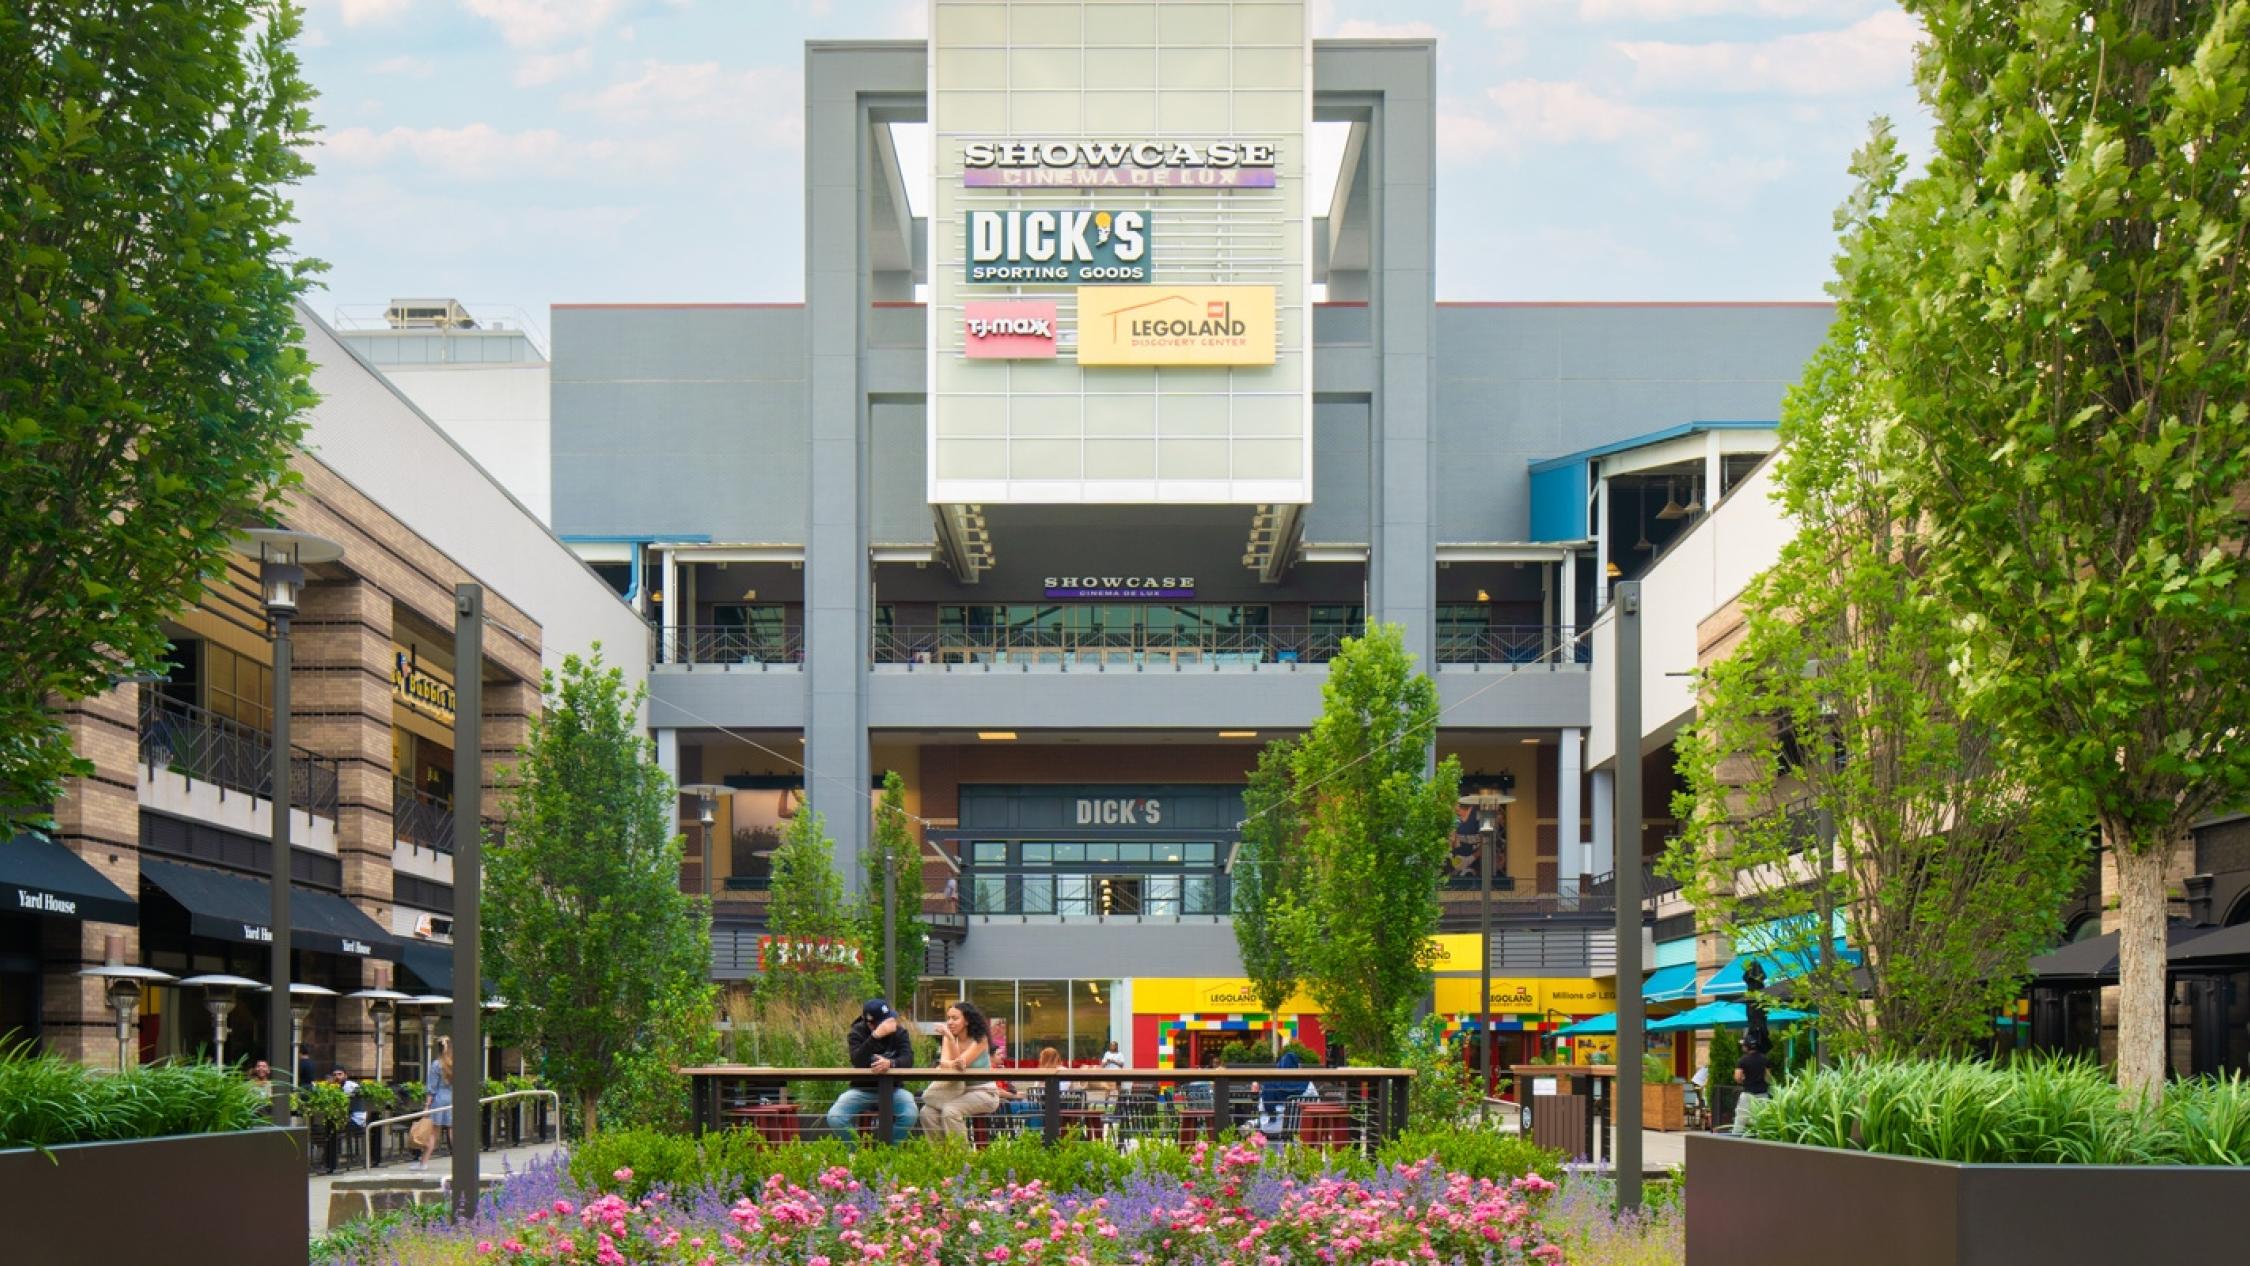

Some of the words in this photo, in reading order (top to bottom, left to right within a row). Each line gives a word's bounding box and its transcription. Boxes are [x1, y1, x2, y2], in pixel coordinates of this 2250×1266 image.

[965, 143, 1275, 168] SHOWCASE
[1003, 169, 1118, 185] CINEMA
[1131, 169, 1168, 185] DE
[1180, 169, 1237, 185] LUX
[973, 211, 1144, 262] DICK'S
[973, 267, 1069, 279] SPORTING
[1079, 267, 1144, 279] GOODS
[1132, 301, 1246, 337] LEGOLAND
[1131, 338, 1196, 347] DISCOVERY
[1201, 338, 1248, 347] CENTER
[1044, 577, 1195, 588] SHOWCASE
[1076, 798, 1160, 824] DICK'S
[18, 889, 43, 909] Yard
[44, 893, 76, 914] House
[244, 924, 260, 940] Yard
[1211, 986, 1256, 1002] LEGOLAND
[1490, 987, 1533, 1002] EGOLAND
[1552, 991, 1584, 1000] Millions
